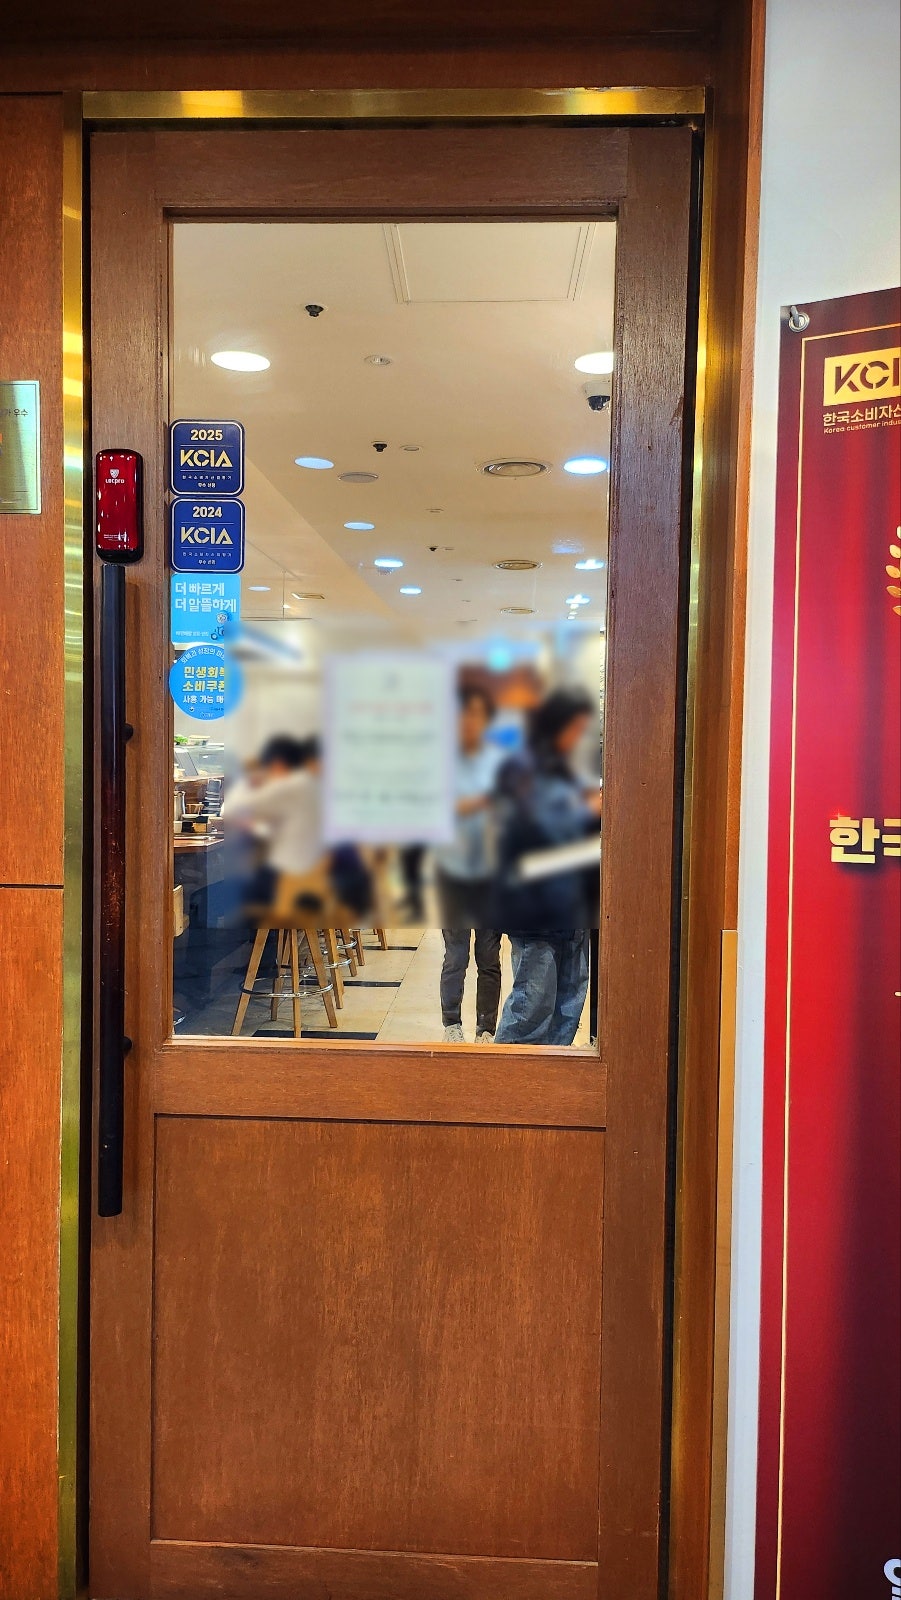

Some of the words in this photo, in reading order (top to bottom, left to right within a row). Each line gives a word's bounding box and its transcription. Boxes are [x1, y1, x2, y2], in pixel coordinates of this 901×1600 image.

[823, 425, 845, 434] Korea
[846, 422, 881, 432] customer
[190, 429, 223, 441] 2025
[180, 449, 233, 468] KCIA
[192, 506, 223, 518] 2024
[180, 526, 233, 545] KCIA
[175, 582, 187, 596] 더
[188, 582, 225, 597] 빠르게
[175, 597, 187, 612] 더
[188, 597, 237, 613] 알뜰하게
[182, 695, 198, 704] 사용
[199, 695, 214, 704] 가능
